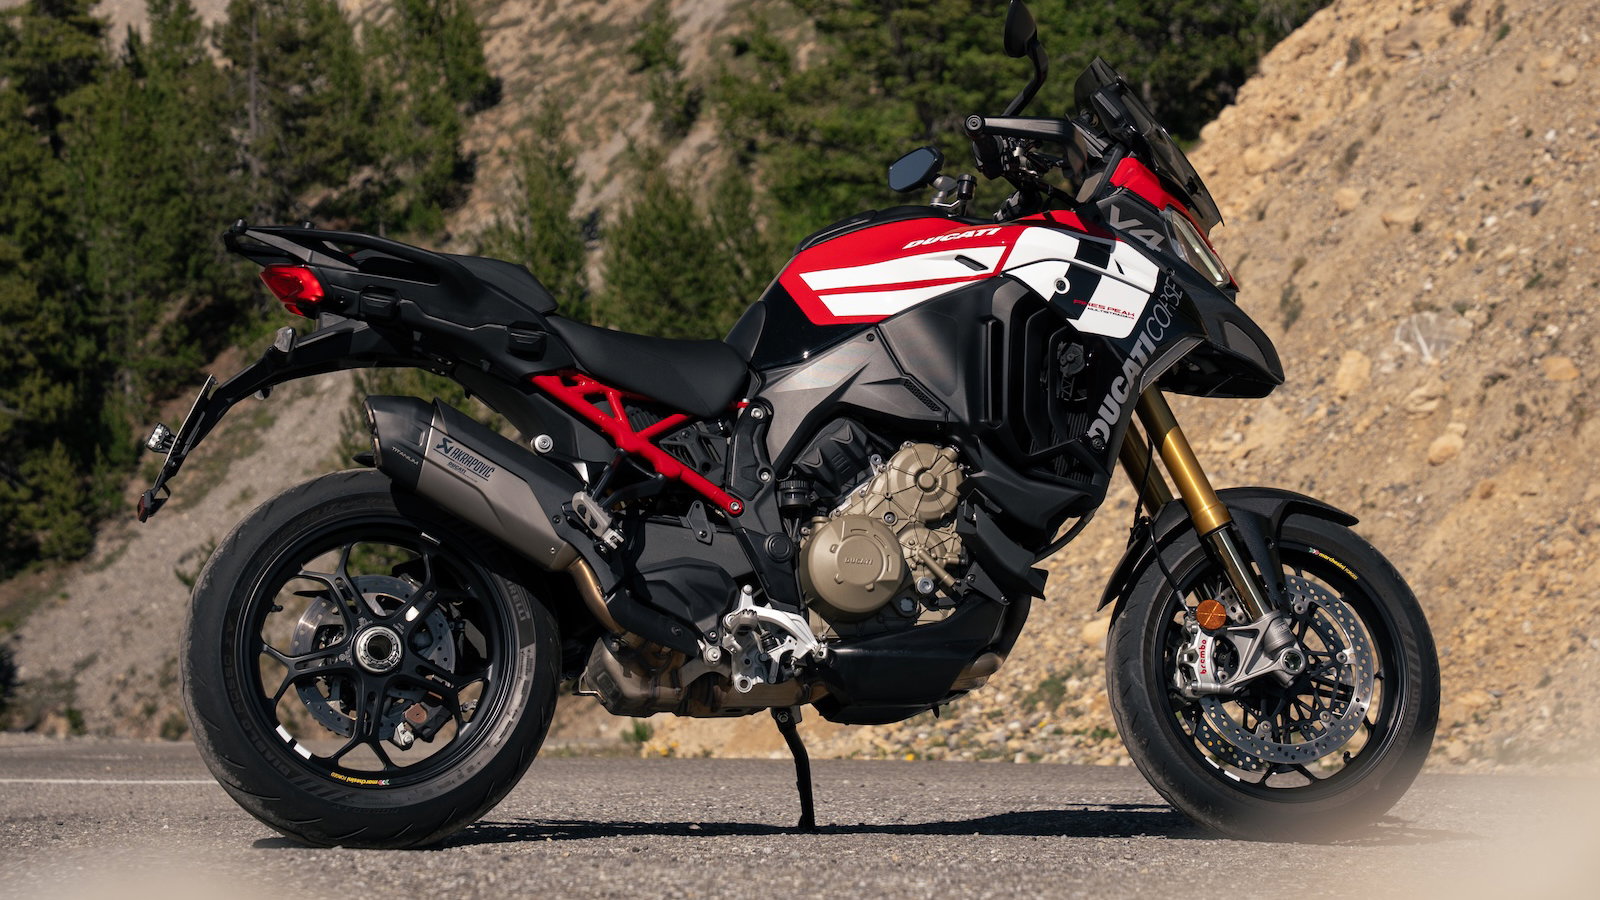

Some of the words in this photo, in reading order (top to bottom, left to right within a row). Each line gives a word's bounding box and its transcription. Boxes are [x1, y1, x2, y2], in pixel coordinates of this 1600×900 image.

[1109, 204, 1165, 252] V4
[902, 227, 1002, 250] DUCATI
[1107, 306, 1135, 317] PEAK
[391, 446, 419, 465] TITANIUM
[447, 461, 467, 475] DUCATI
[844, 557, 874, 565] DUCATI
[1198, 639, 1208, 675] brembo
